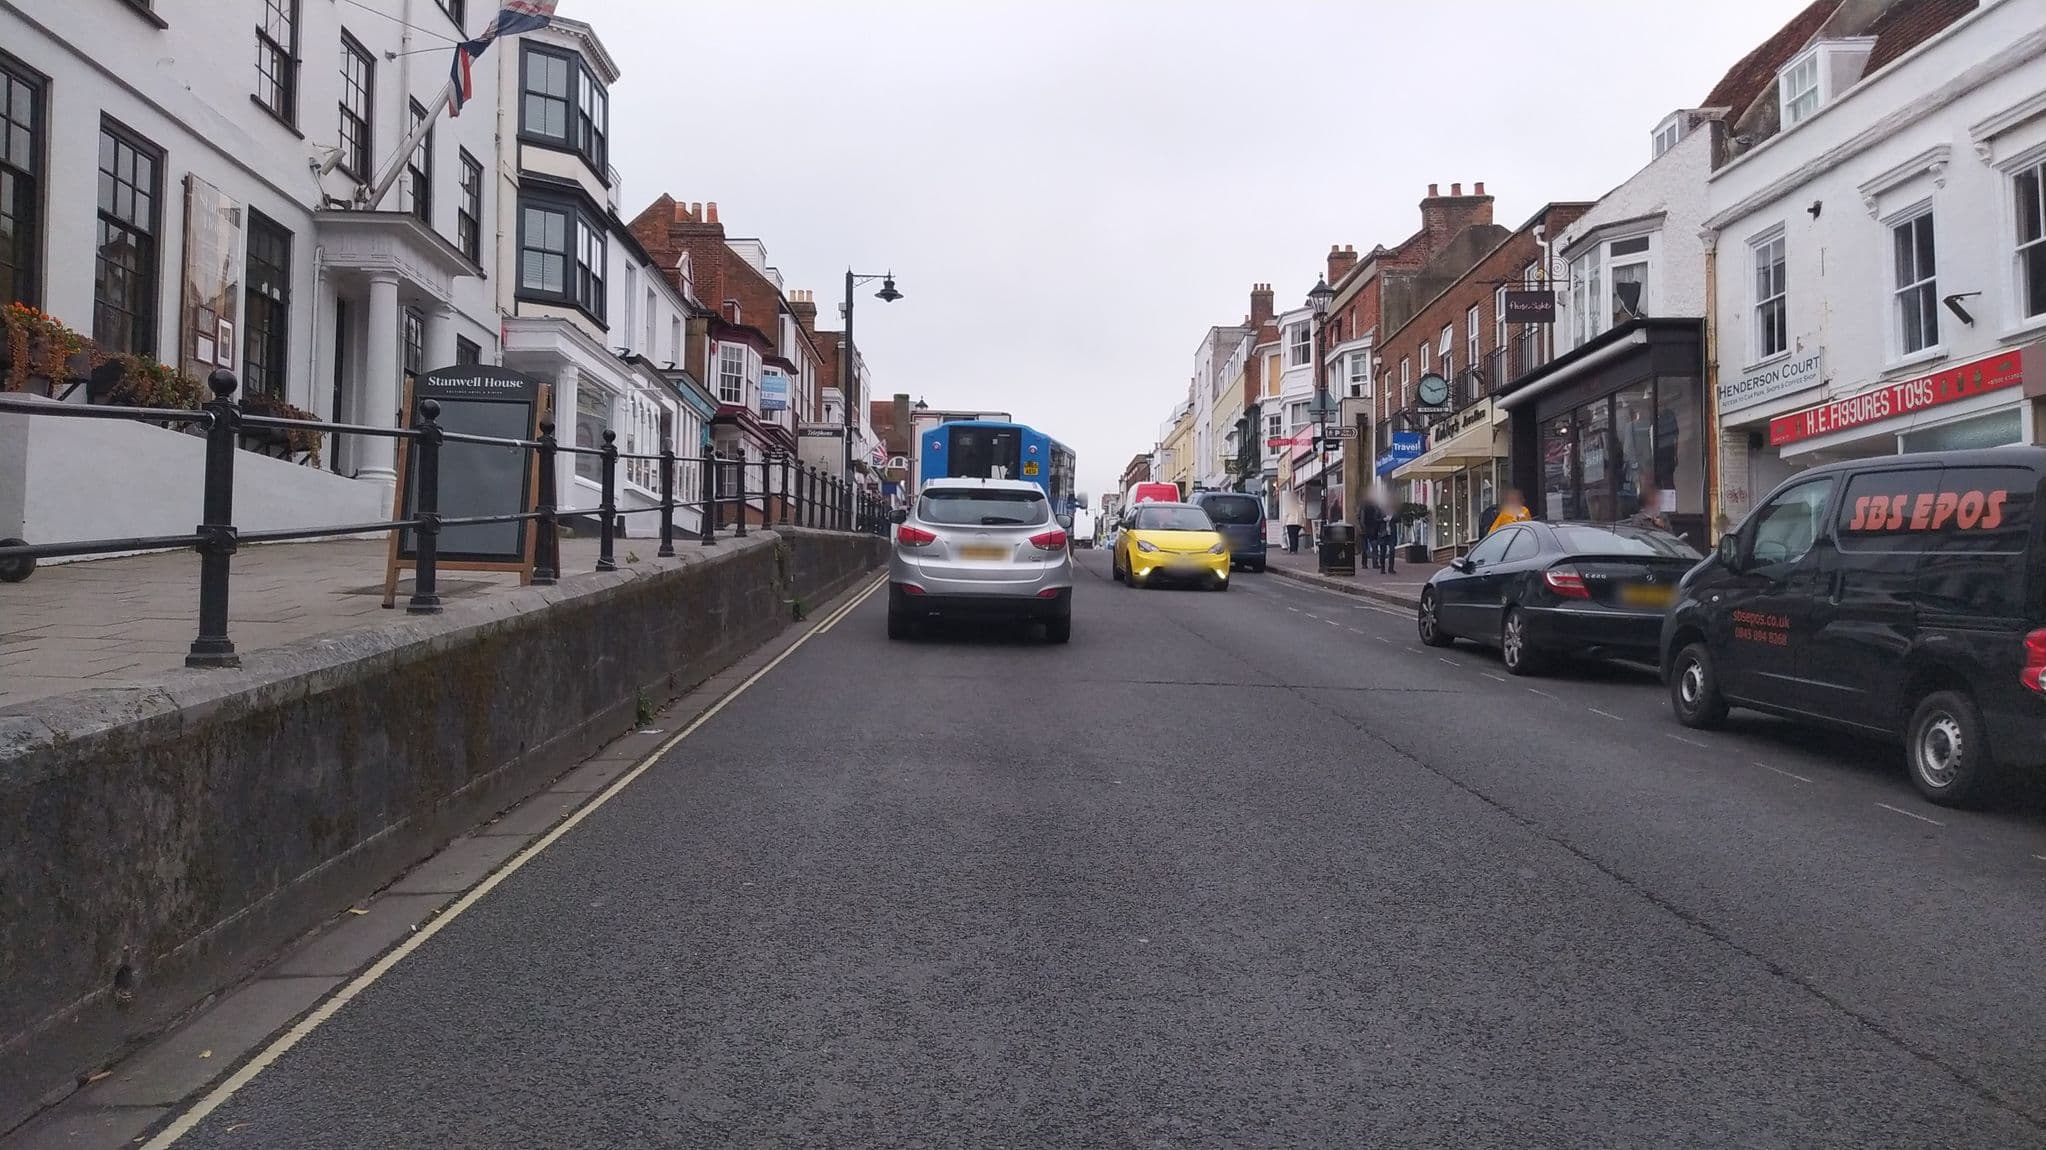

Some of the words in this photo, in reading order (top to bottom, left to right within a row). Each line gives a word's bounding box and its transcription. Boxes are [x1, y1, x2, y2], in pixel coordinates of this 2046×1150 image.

[428, 376, 481, 387] Stanwell
[484, 377, 524, 388] House
[1719, 369, 1780, 398] HENDERSON
[1782, 356, 1820, 378] COURT
[1849, 494, 1908, 530] SBS
[1910, 489, 2007, 530] EPOS
[1732, 608, 1790, 629] sbsepos.co.uk
